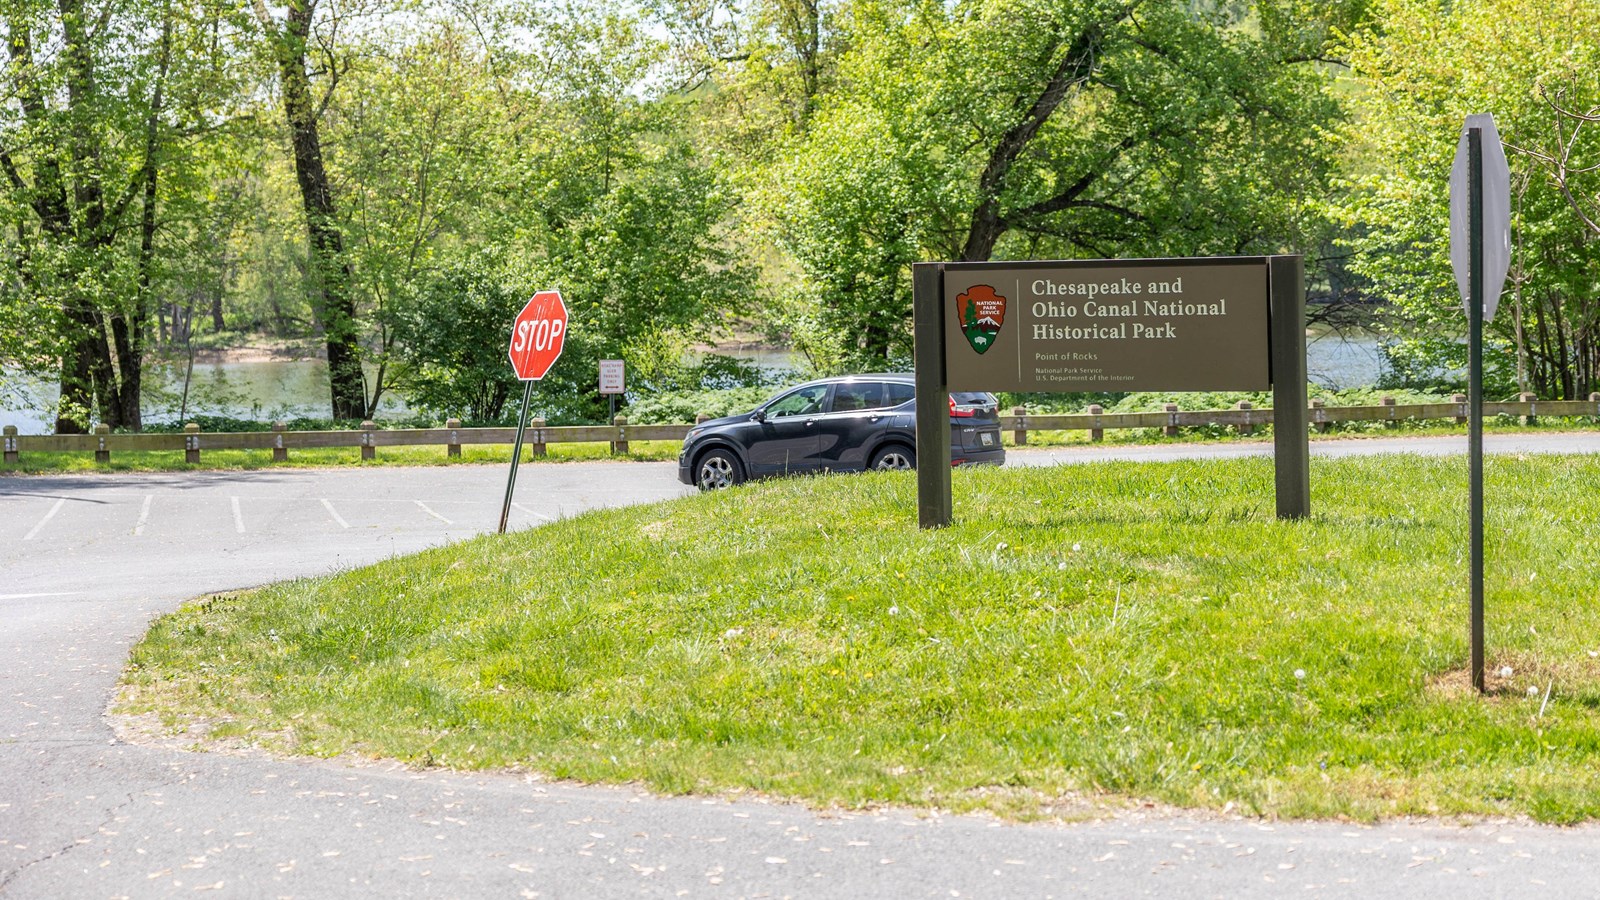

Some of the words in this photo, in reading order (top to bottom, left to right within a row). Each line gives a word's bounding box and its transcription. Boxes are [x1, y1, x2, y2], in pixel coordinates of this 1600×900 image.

[1031, 278, 1142, 299] Chesapeake
[1147, 277, 1183, 294] and
[1031, 301, 1078, 318] Ohio
[1083, 300, 1138, 317] Canal
[1143, 299, 1227, 316] National
[514, 319, 562, 352] STOP
[1032, 322, 1127, 340] Historical
[1132, 322, 1177, 339] Park
[1035, 352, 1058, 360] Point
[1060, 352, 1070, 360] of
[1072, 352, 1098, 360] Rocks
